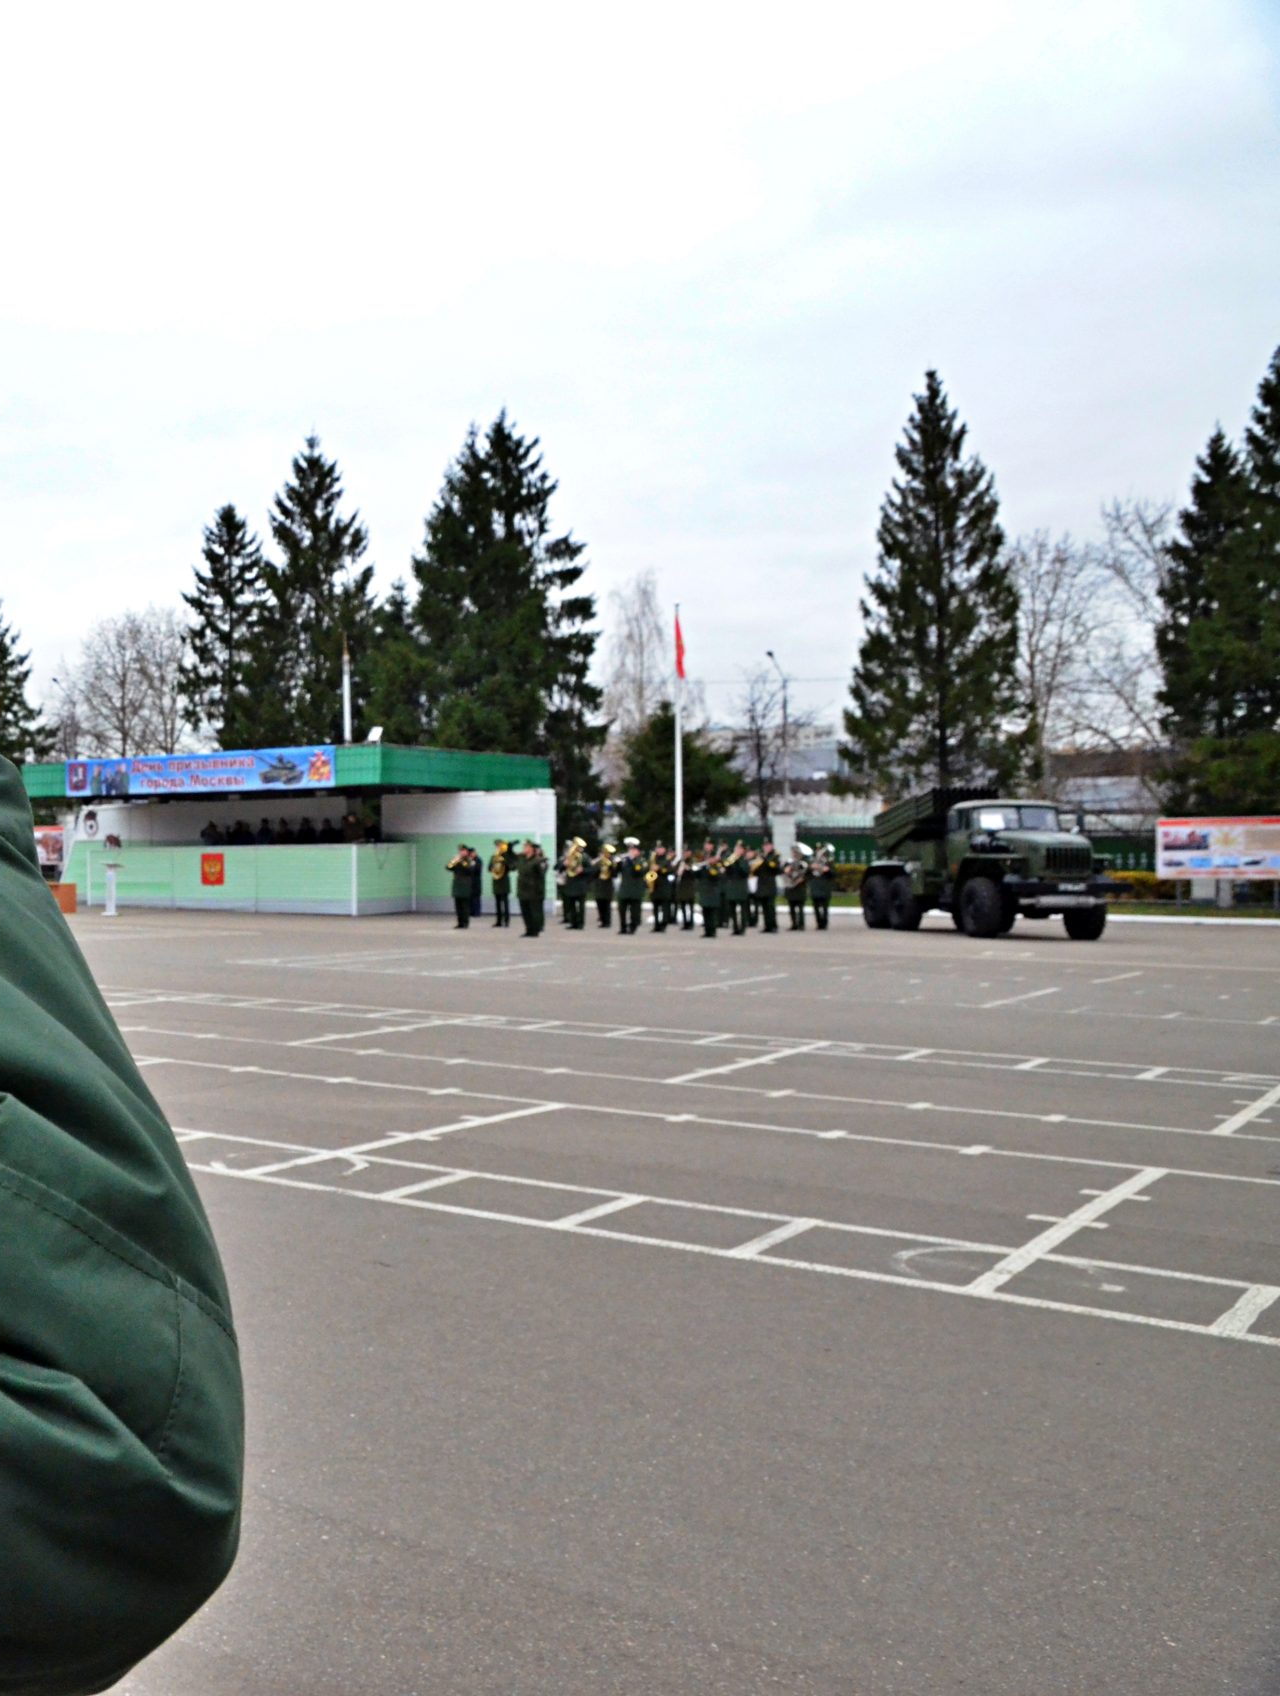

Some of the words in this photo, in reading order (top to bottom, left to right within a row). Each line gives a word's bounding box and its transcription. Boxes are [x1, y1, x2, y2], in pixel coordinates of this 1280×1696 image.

[132, 760, 164, 773] День
[169, 757, 255, 772] призывника
[141, 777, 185, 790] города
[190, 774, 245, 787] Москвы
